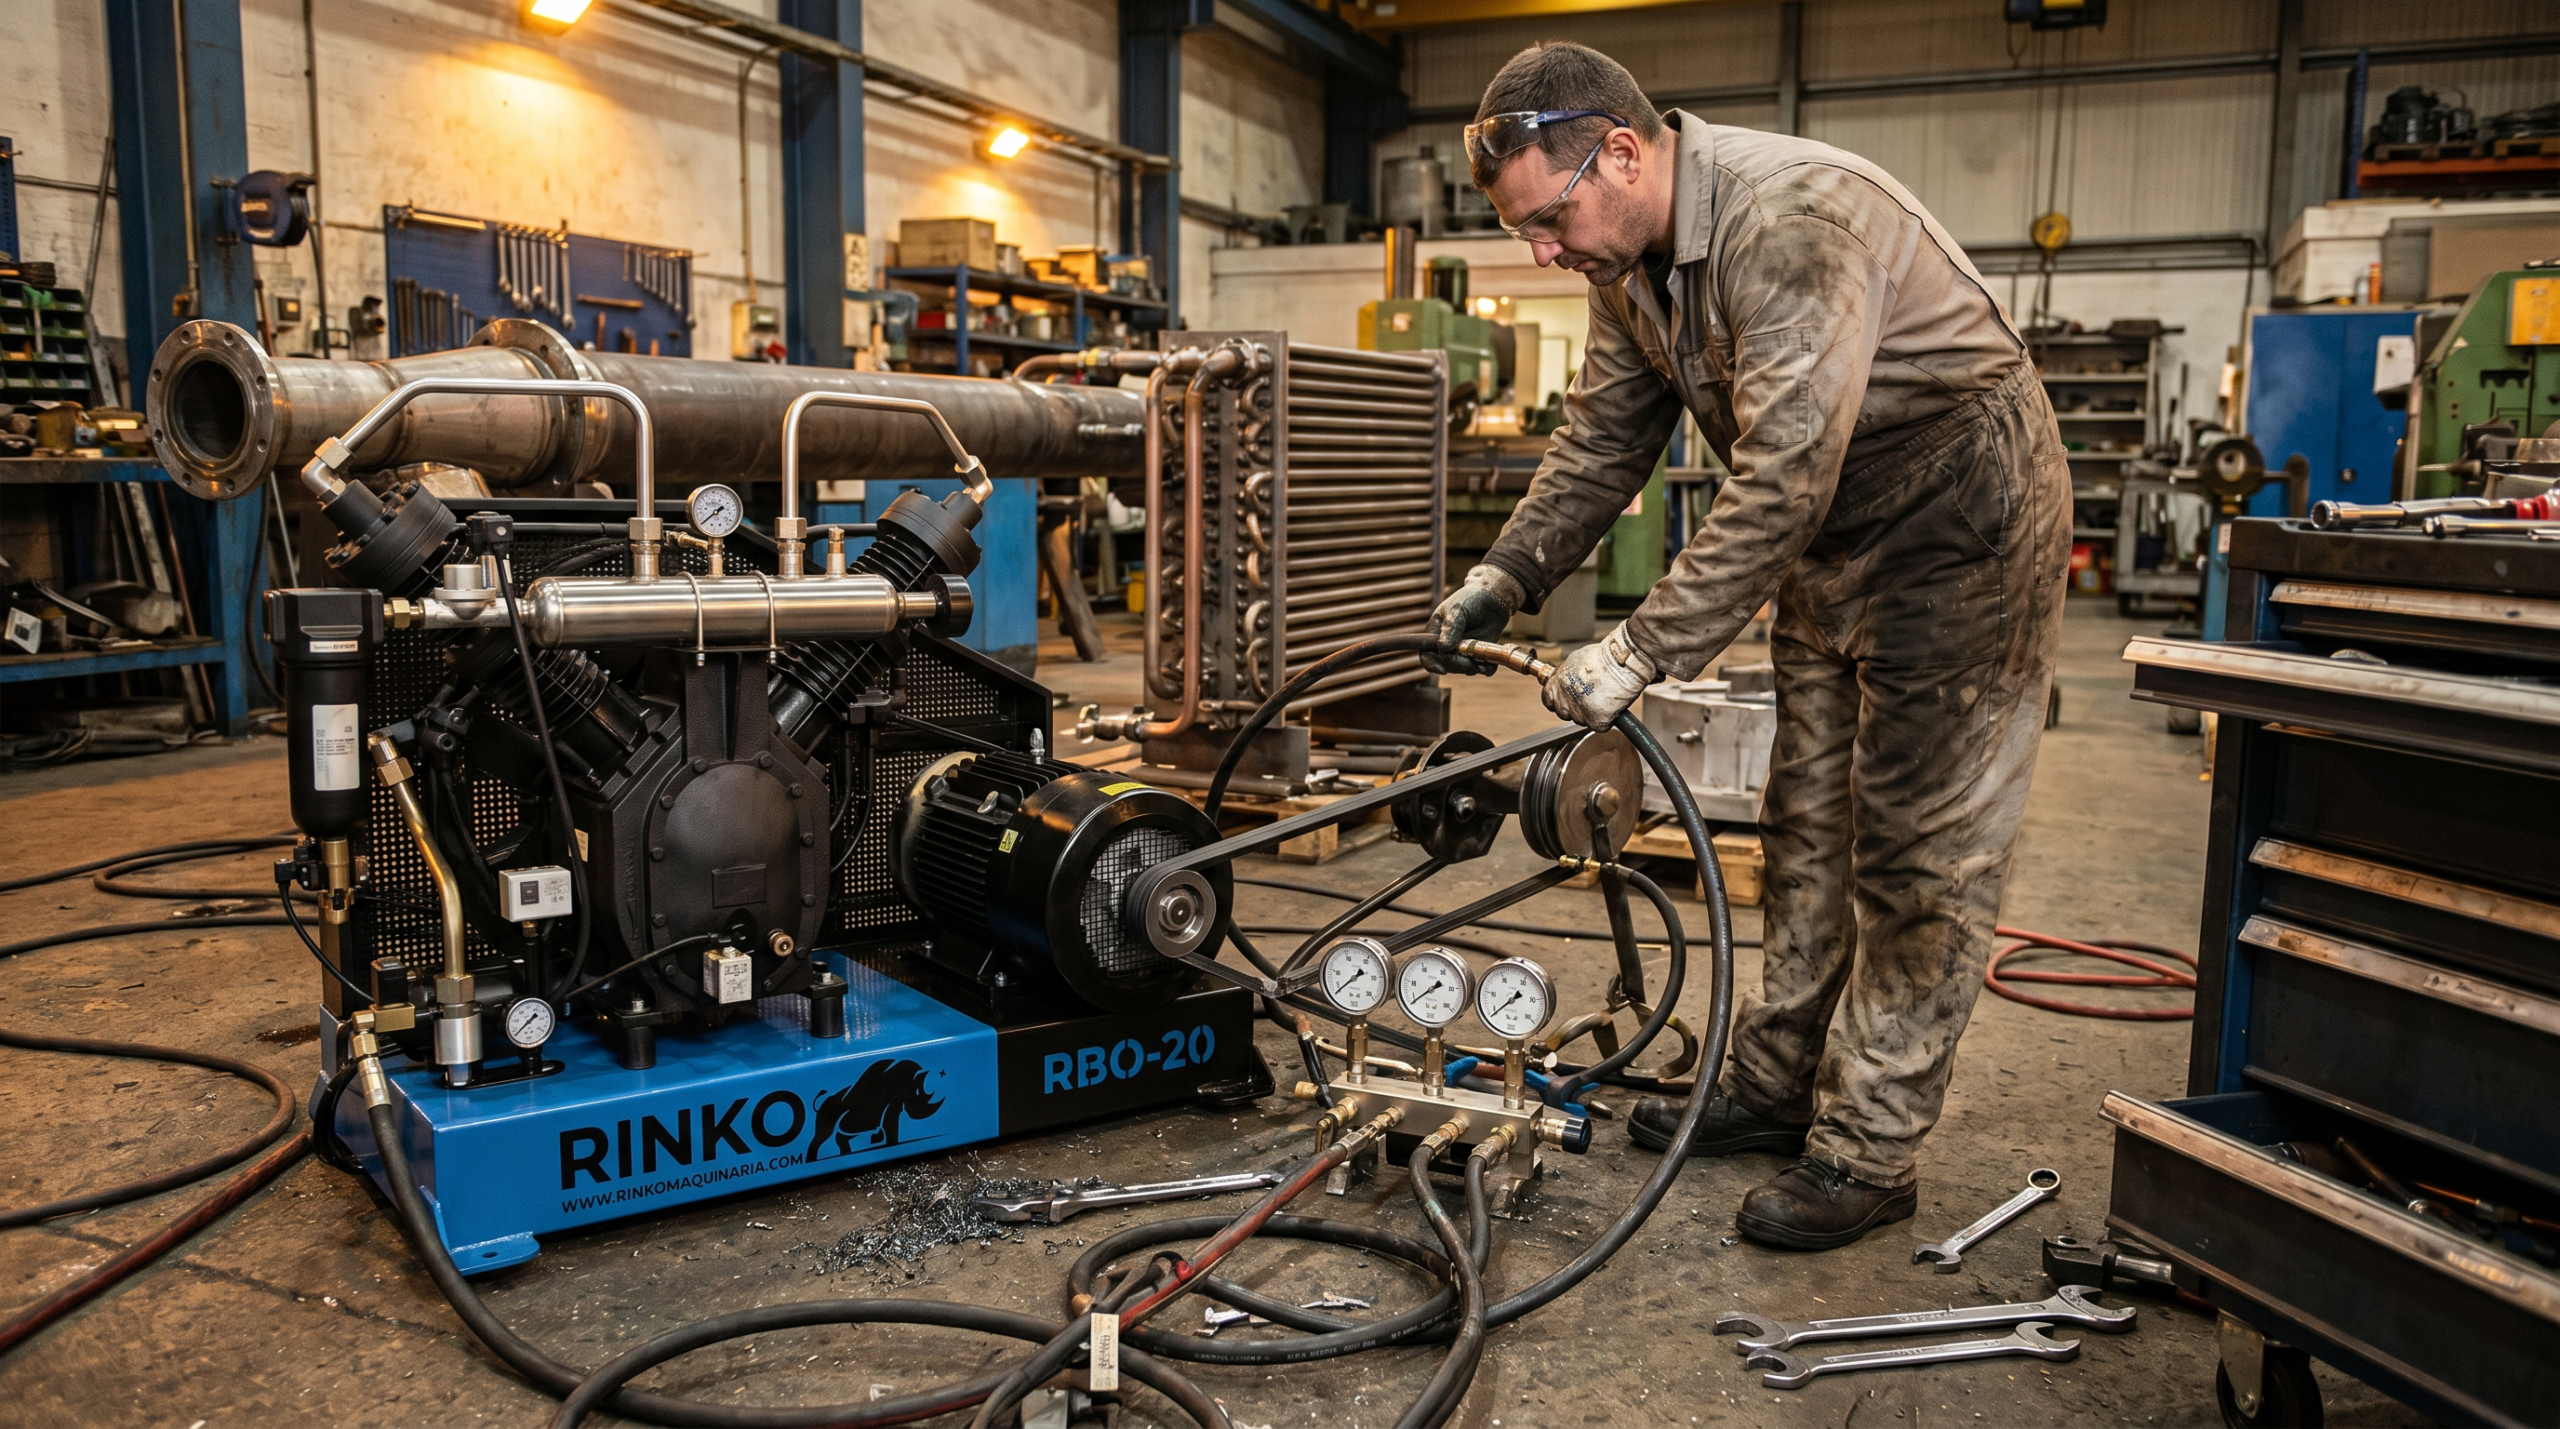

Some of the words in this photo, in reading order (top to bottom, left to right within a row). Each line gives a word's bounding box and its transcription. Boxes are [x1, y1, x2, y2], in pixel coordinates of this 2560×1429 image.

[1044, 1025, 1215, 1094] RBO-20
[560, 1090, 806, 1190] RINKO
[561, 1153, 803, 1213] WWW.RINKOMAQUINARIA.COM
